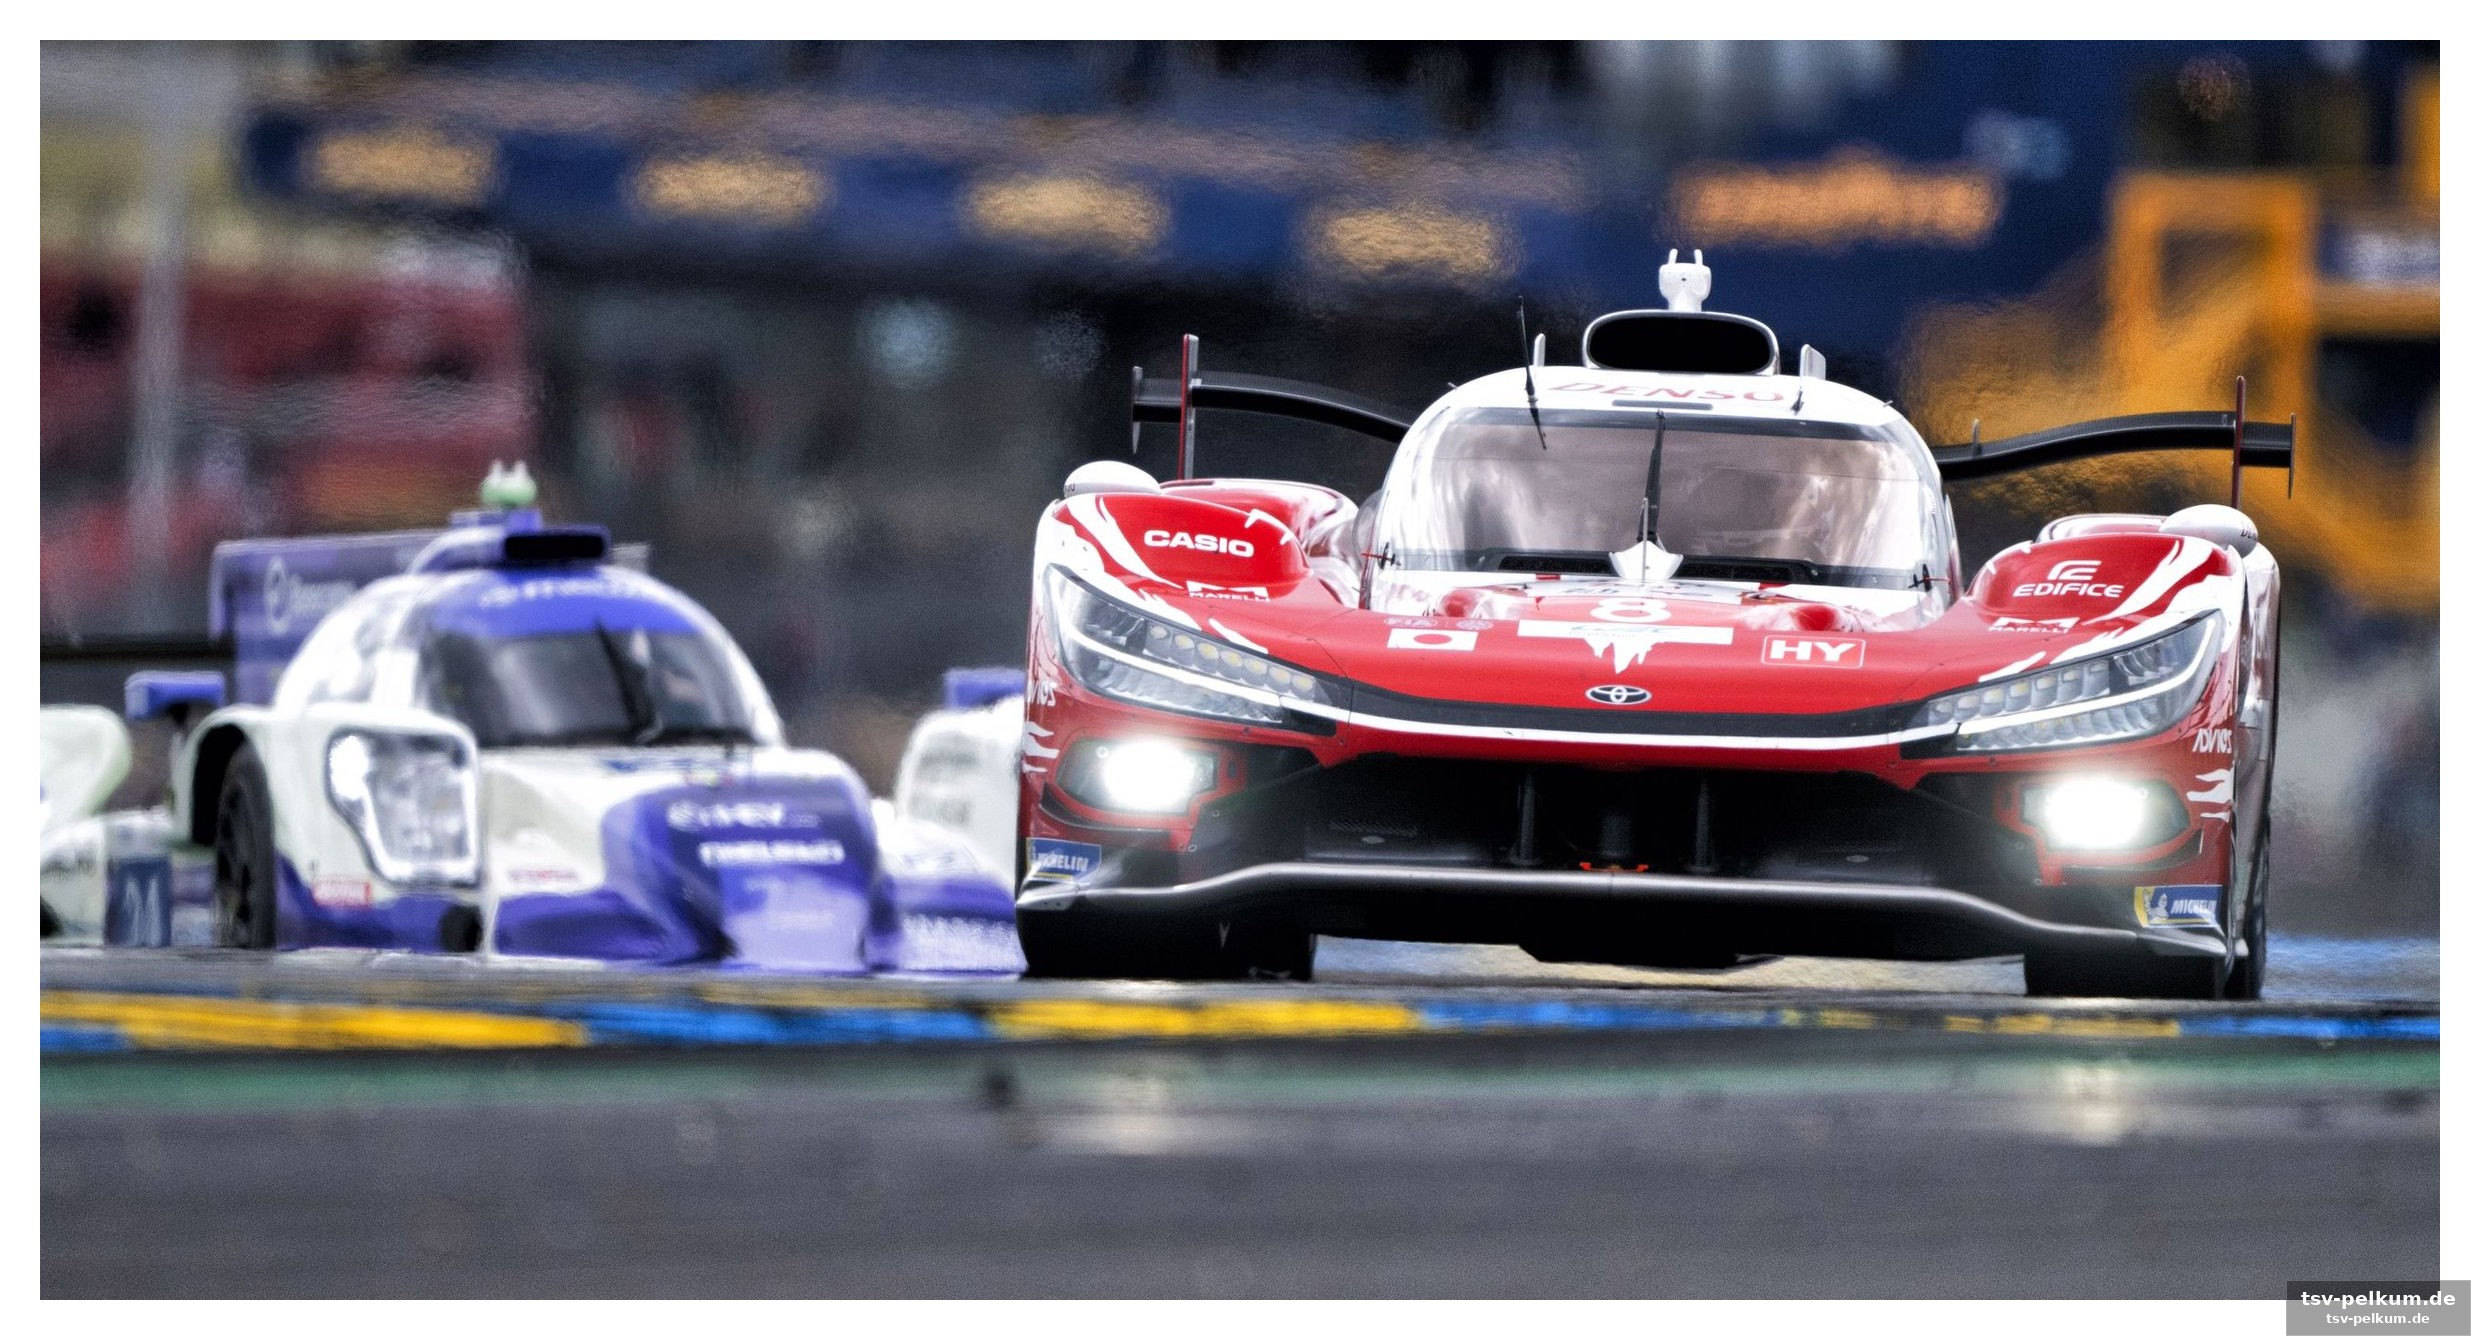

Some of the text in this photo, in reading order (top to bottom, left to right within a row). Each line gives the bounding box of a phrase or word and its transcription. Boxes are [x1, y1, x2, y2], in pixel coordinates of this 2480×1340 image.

[1548, 382, 1785, 402] DENSO
[1143, 529, 1255, 558] CASIO
[2012, 583, 2125, 598] EDIFICE
[1590, 597, 1672, 624] 8
[1770, 639, 1857, 662] HY
[2170, 899, 2217, 915] MICHELIN
